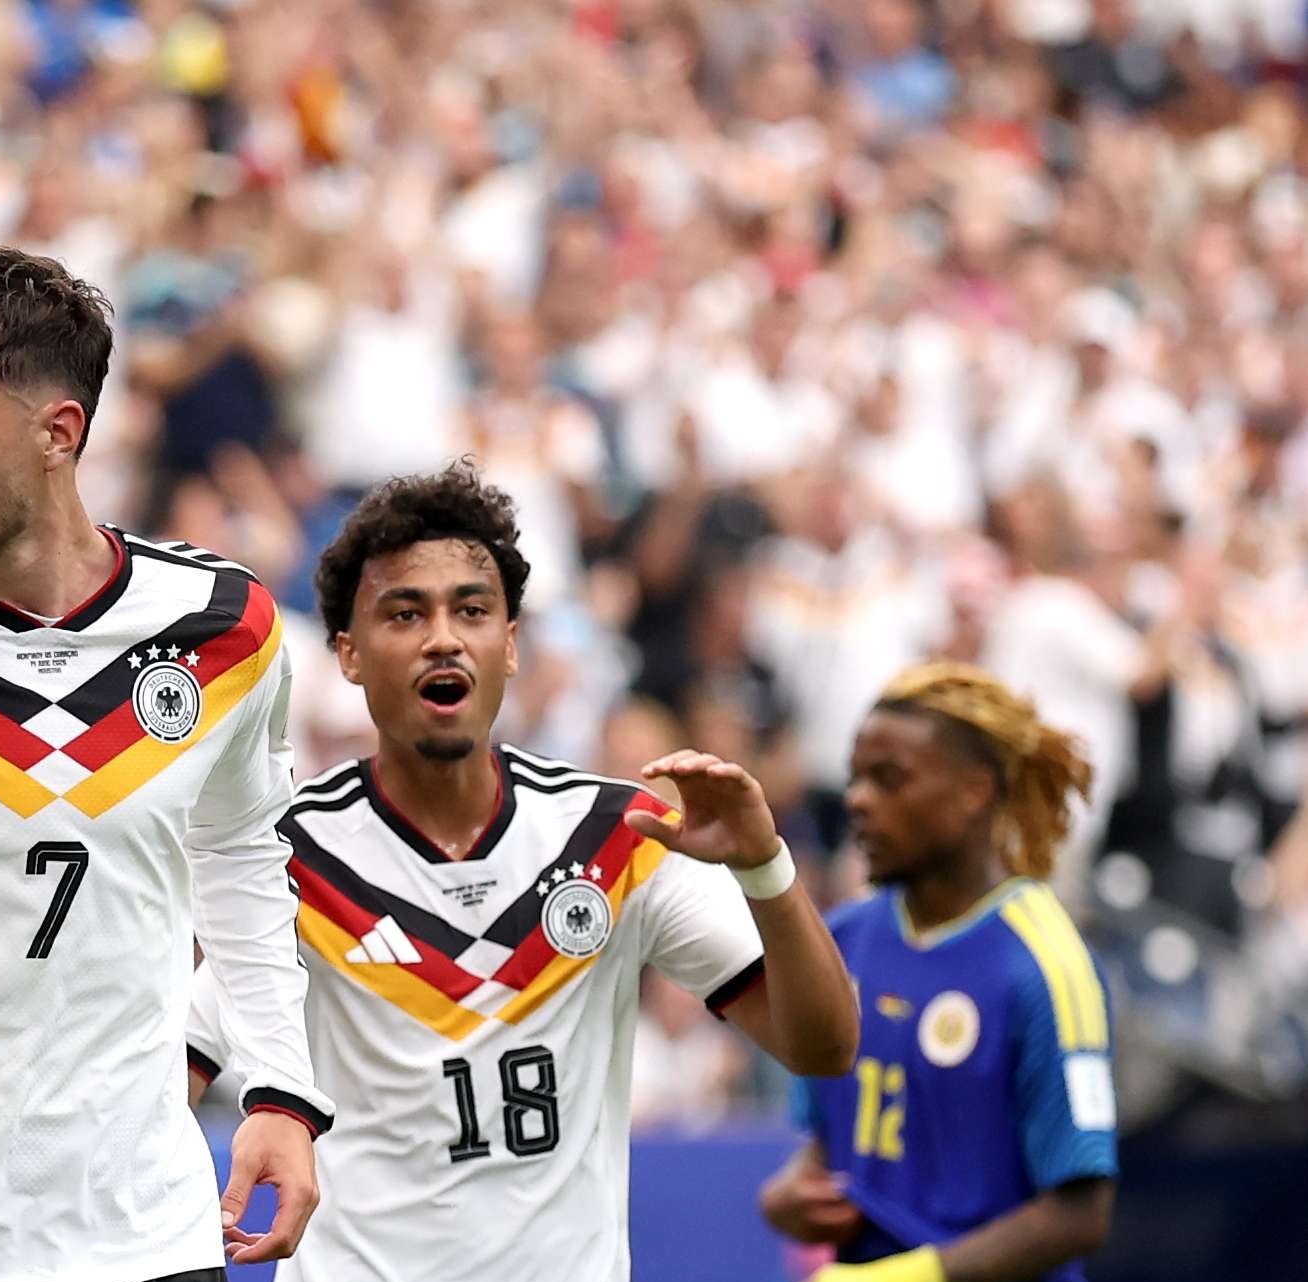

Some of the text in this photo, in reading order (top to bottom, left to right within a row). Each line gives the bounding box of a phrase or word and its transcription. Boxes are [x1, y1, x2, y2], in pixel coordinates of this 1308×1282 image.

[25, 841, 89, 960] 7
[442, 1044, 560, 1163] 18
[854, 1056, 907, 1163] 12
